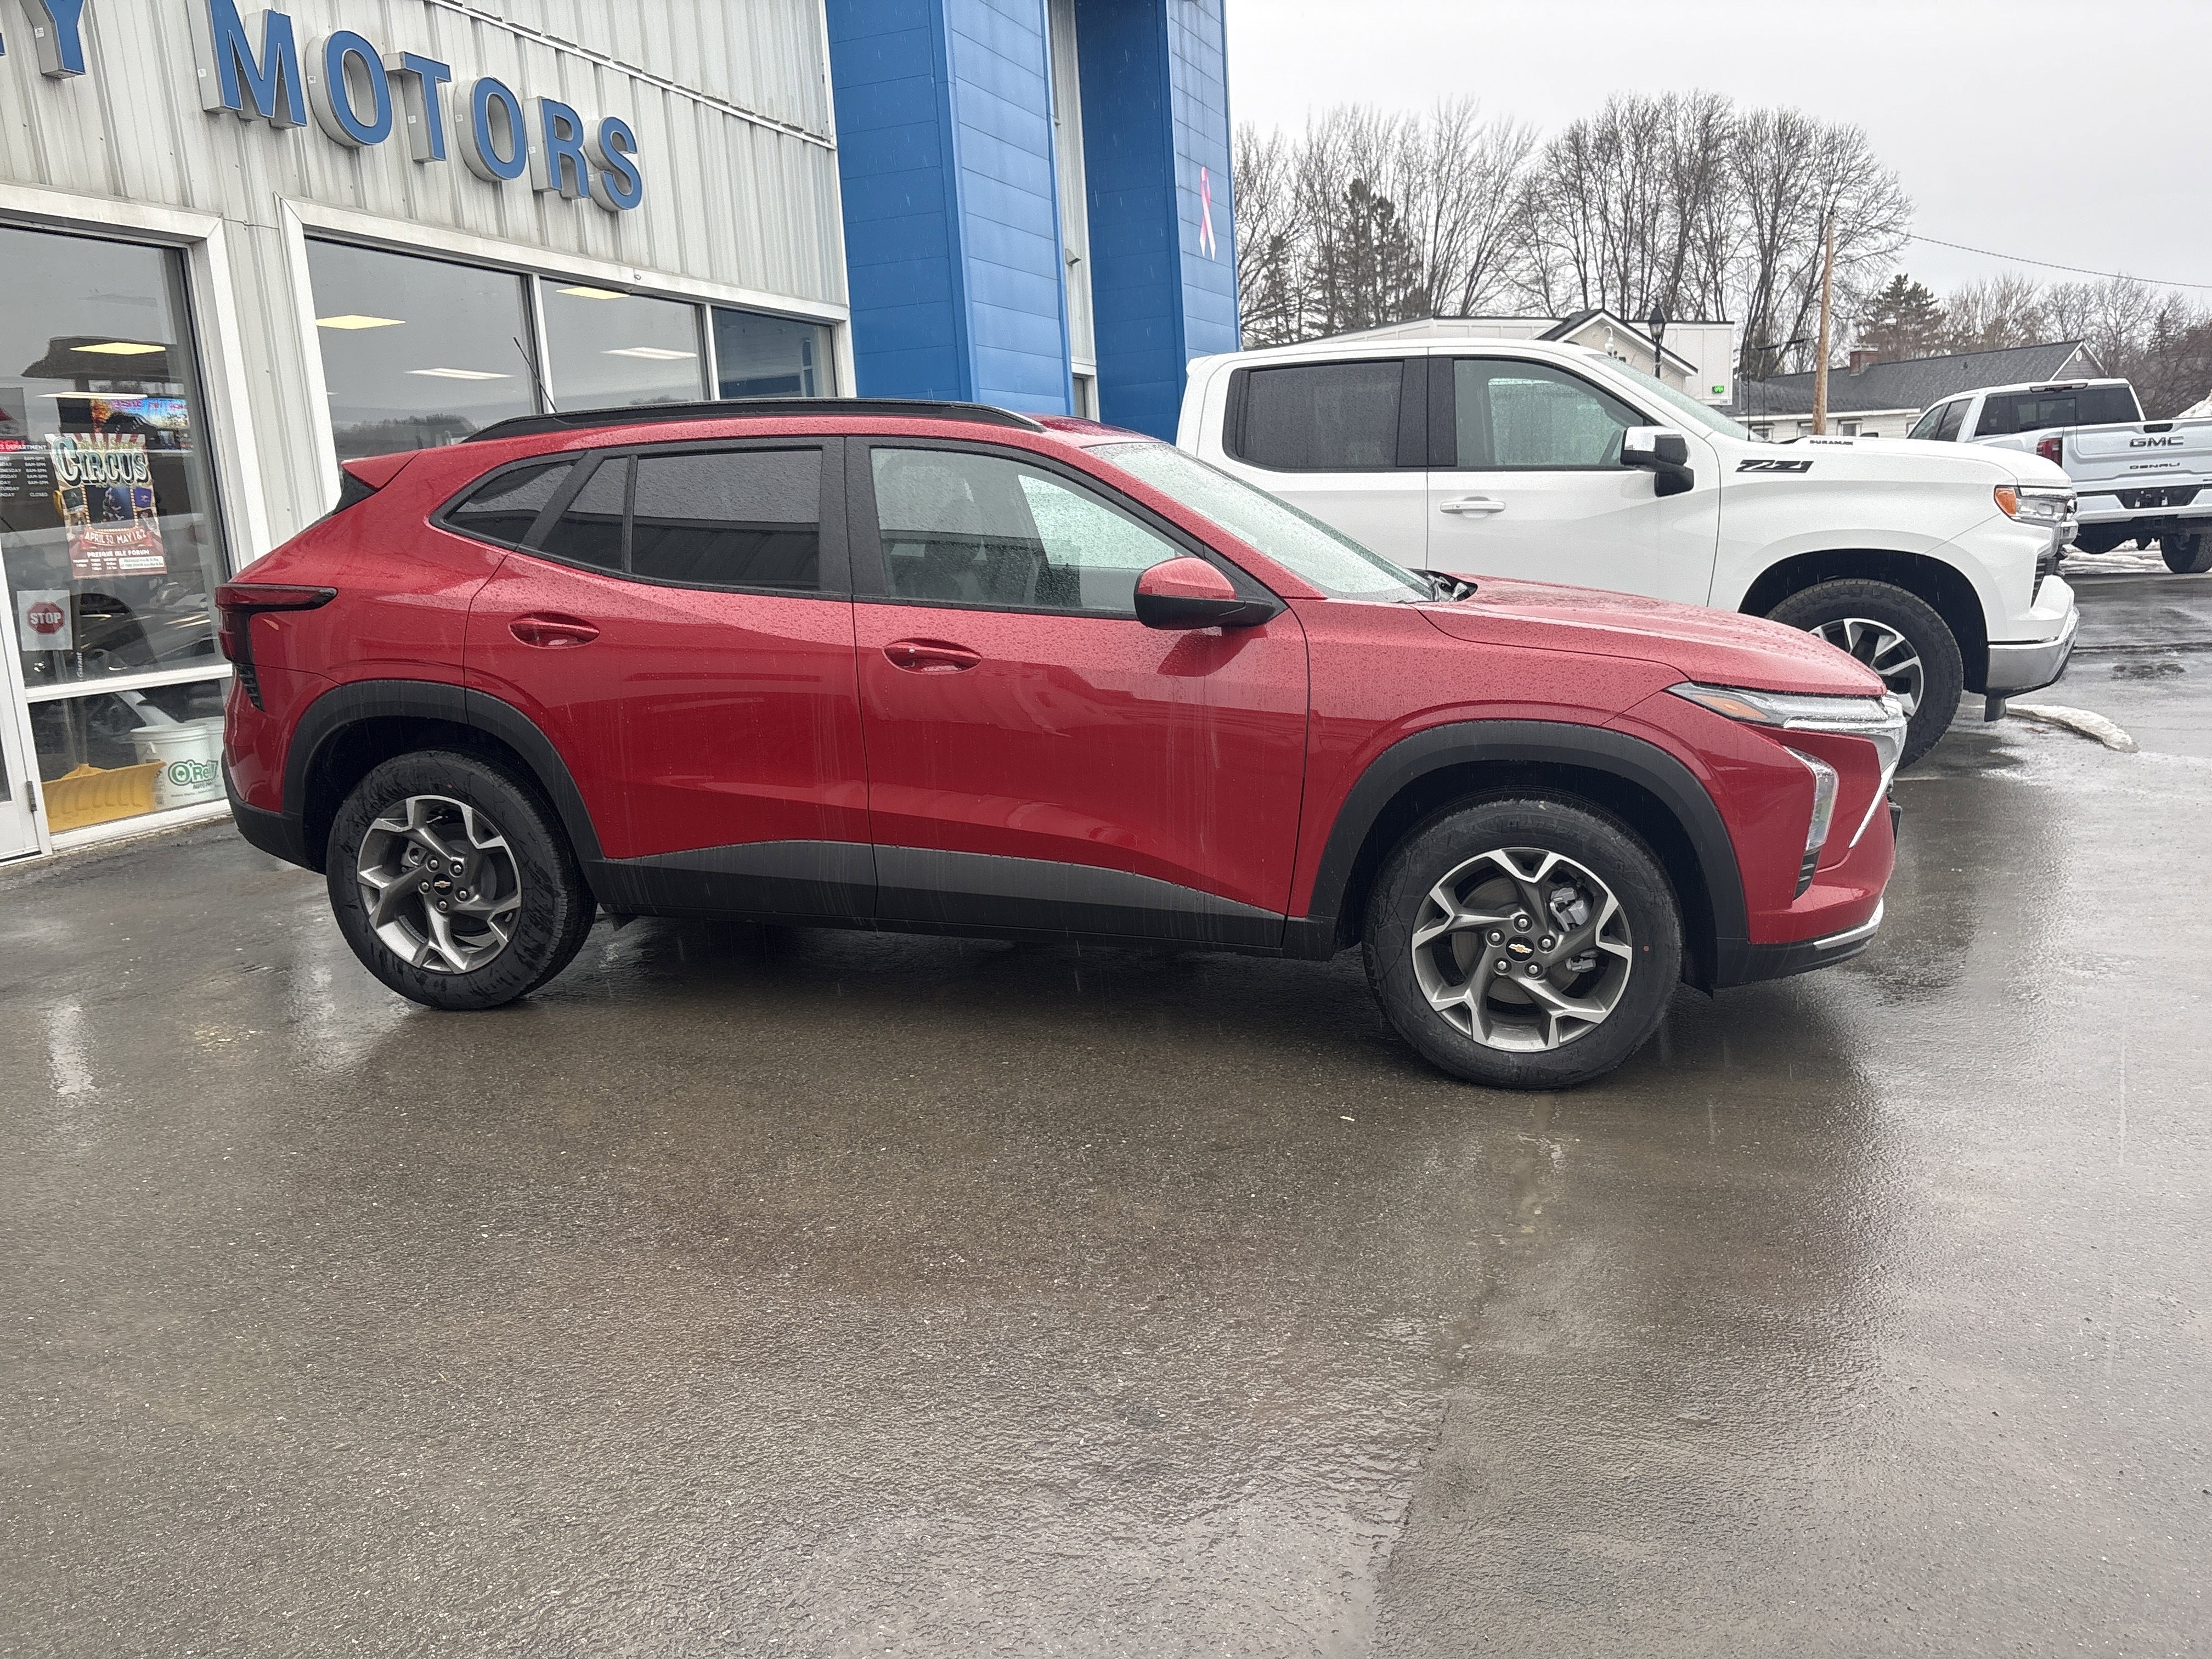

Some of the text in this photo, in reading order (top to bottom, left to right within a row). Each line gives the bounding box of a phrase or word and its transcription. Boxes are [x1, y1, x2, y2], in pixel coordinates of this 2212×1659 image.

[189, 0, 643, 212] MOTORS
[2129, 436, 2184, 448] GMC
[52, 437, 149, 487] CIRCUS
[84, 532, 105, 544] APRIL
[116, 533, 132, 544] MAY
[30, 612, 61, 624] STOP
